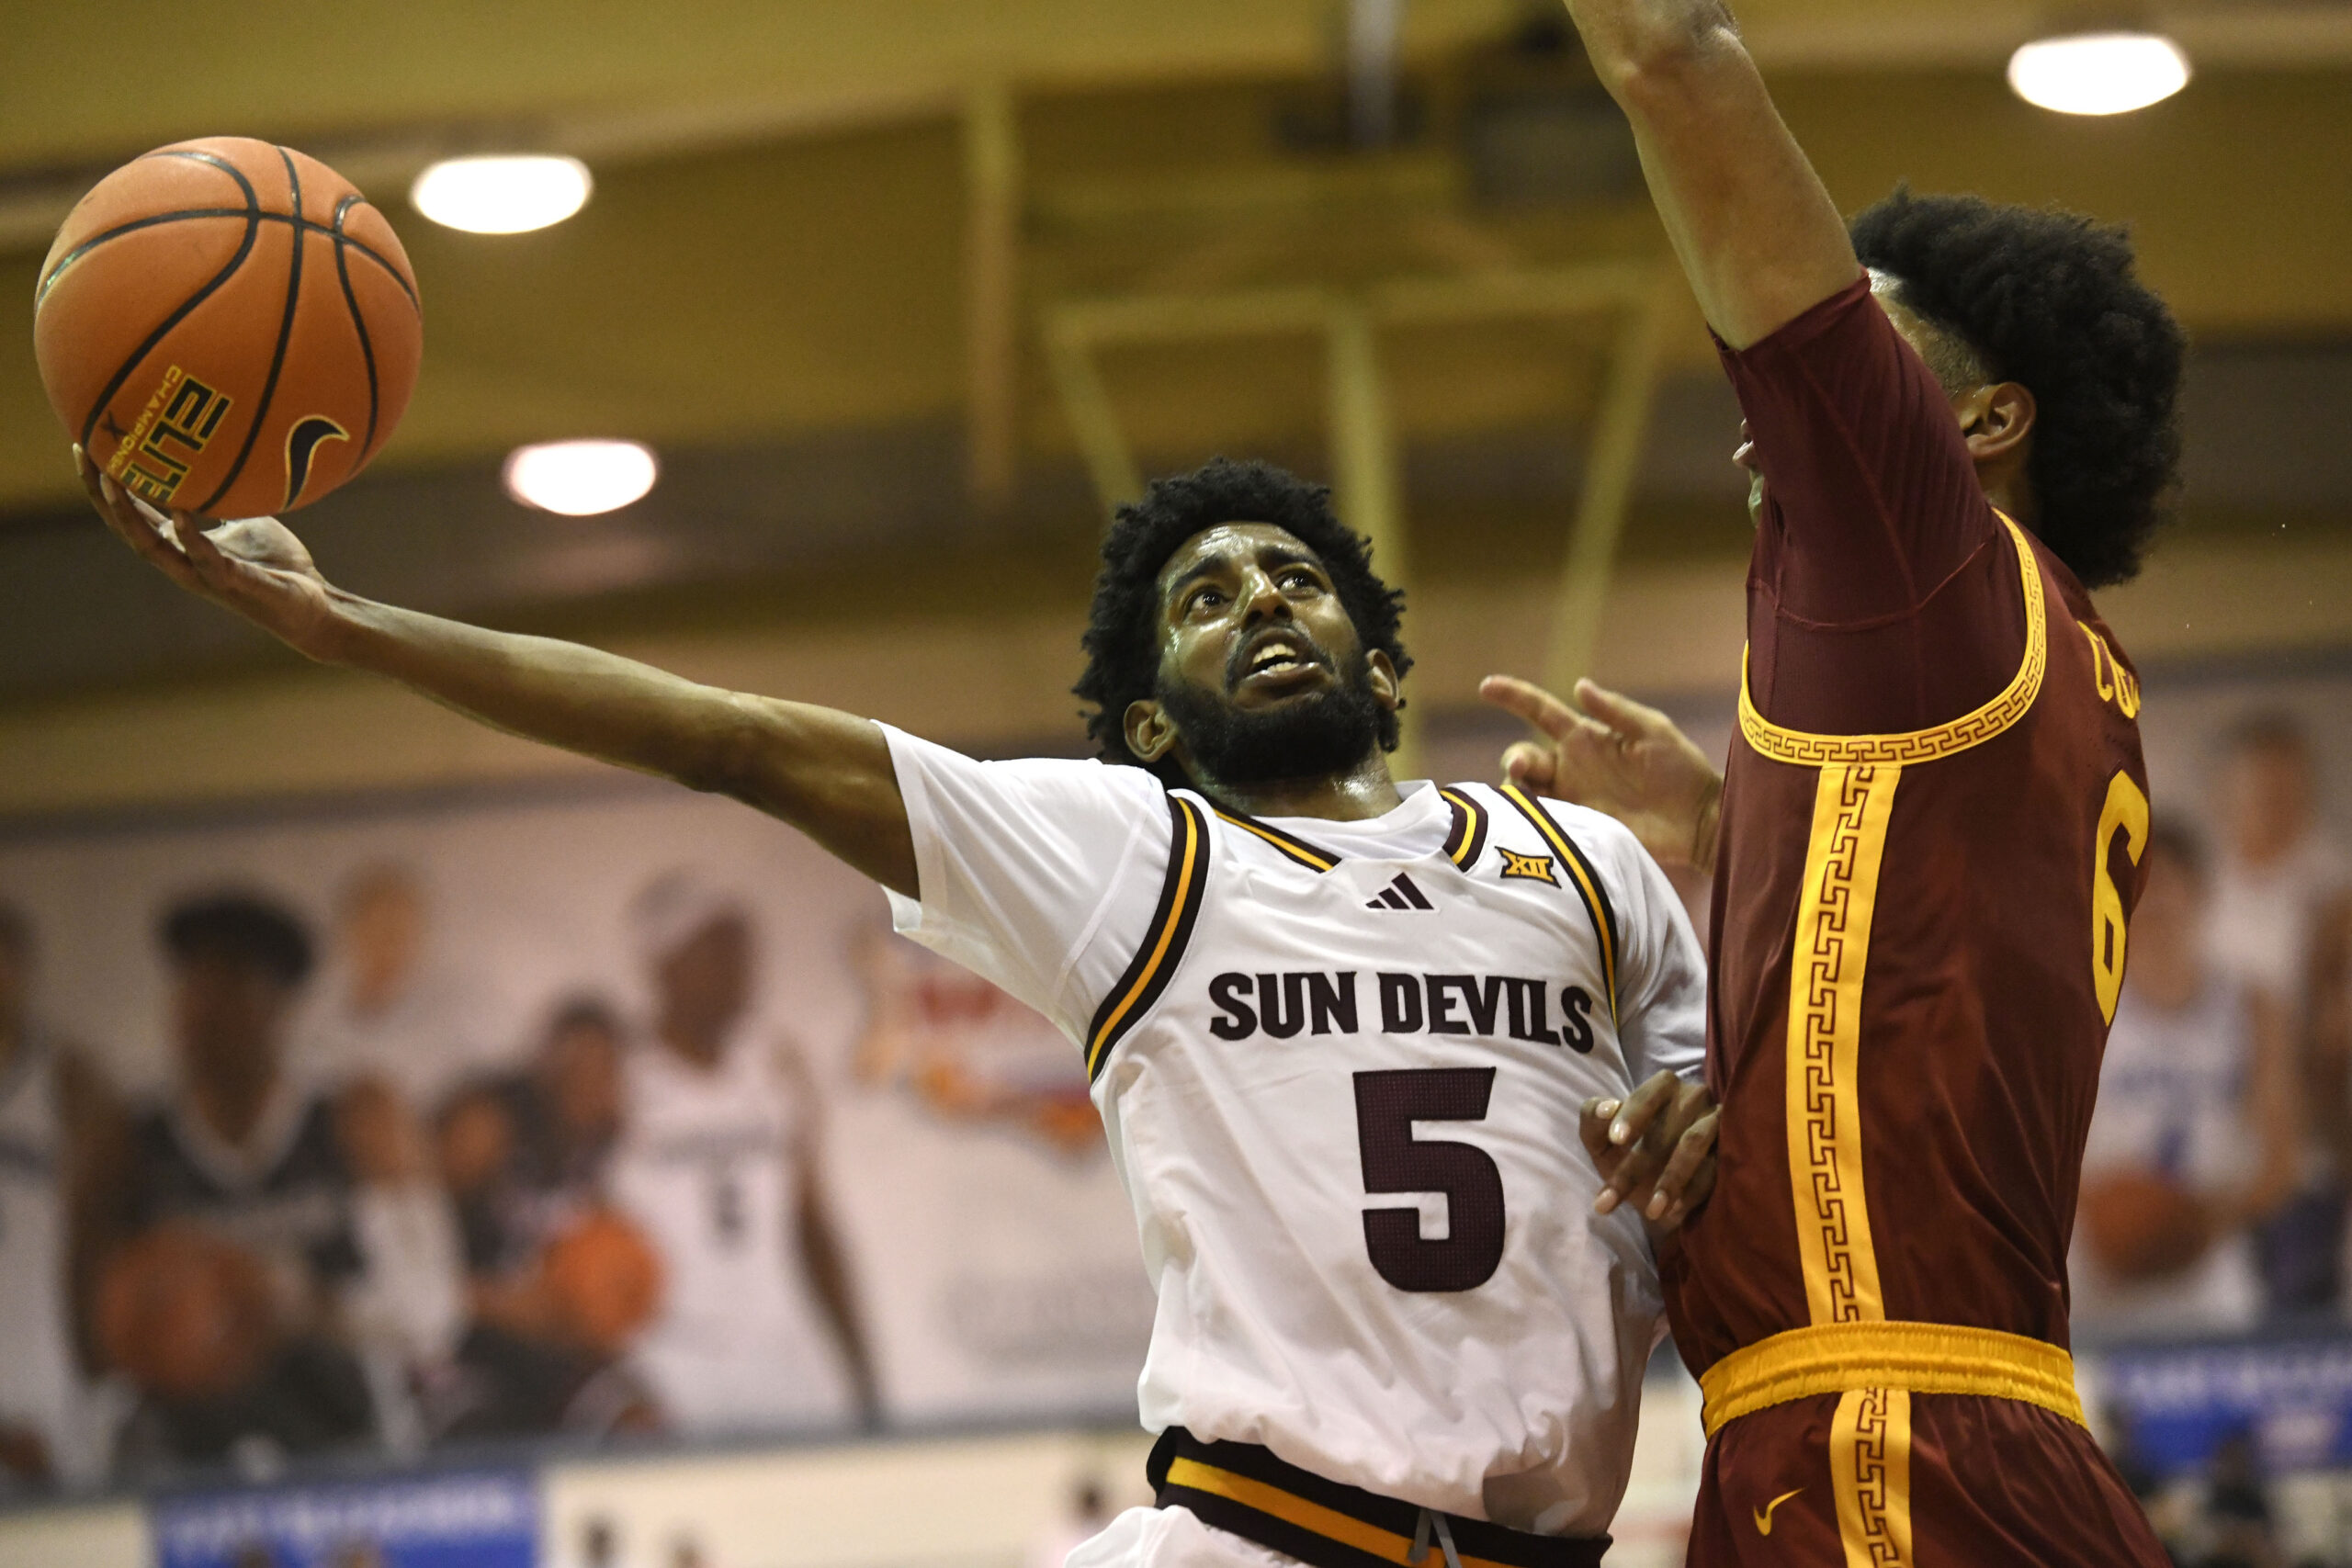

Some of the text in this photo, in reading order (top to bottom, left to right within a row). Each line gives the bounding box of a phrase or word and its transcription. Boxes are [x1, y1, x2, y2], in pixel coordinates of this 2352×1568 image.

[120, 374, 233, 503] ELITE
[1498, 847, 1558, 886] XII
[2092, 770, 2149, 1027] 6
[1208, 971, 1595, 1055] SUN DEVILS
[1351, 1066, 1507, 1293] 5
